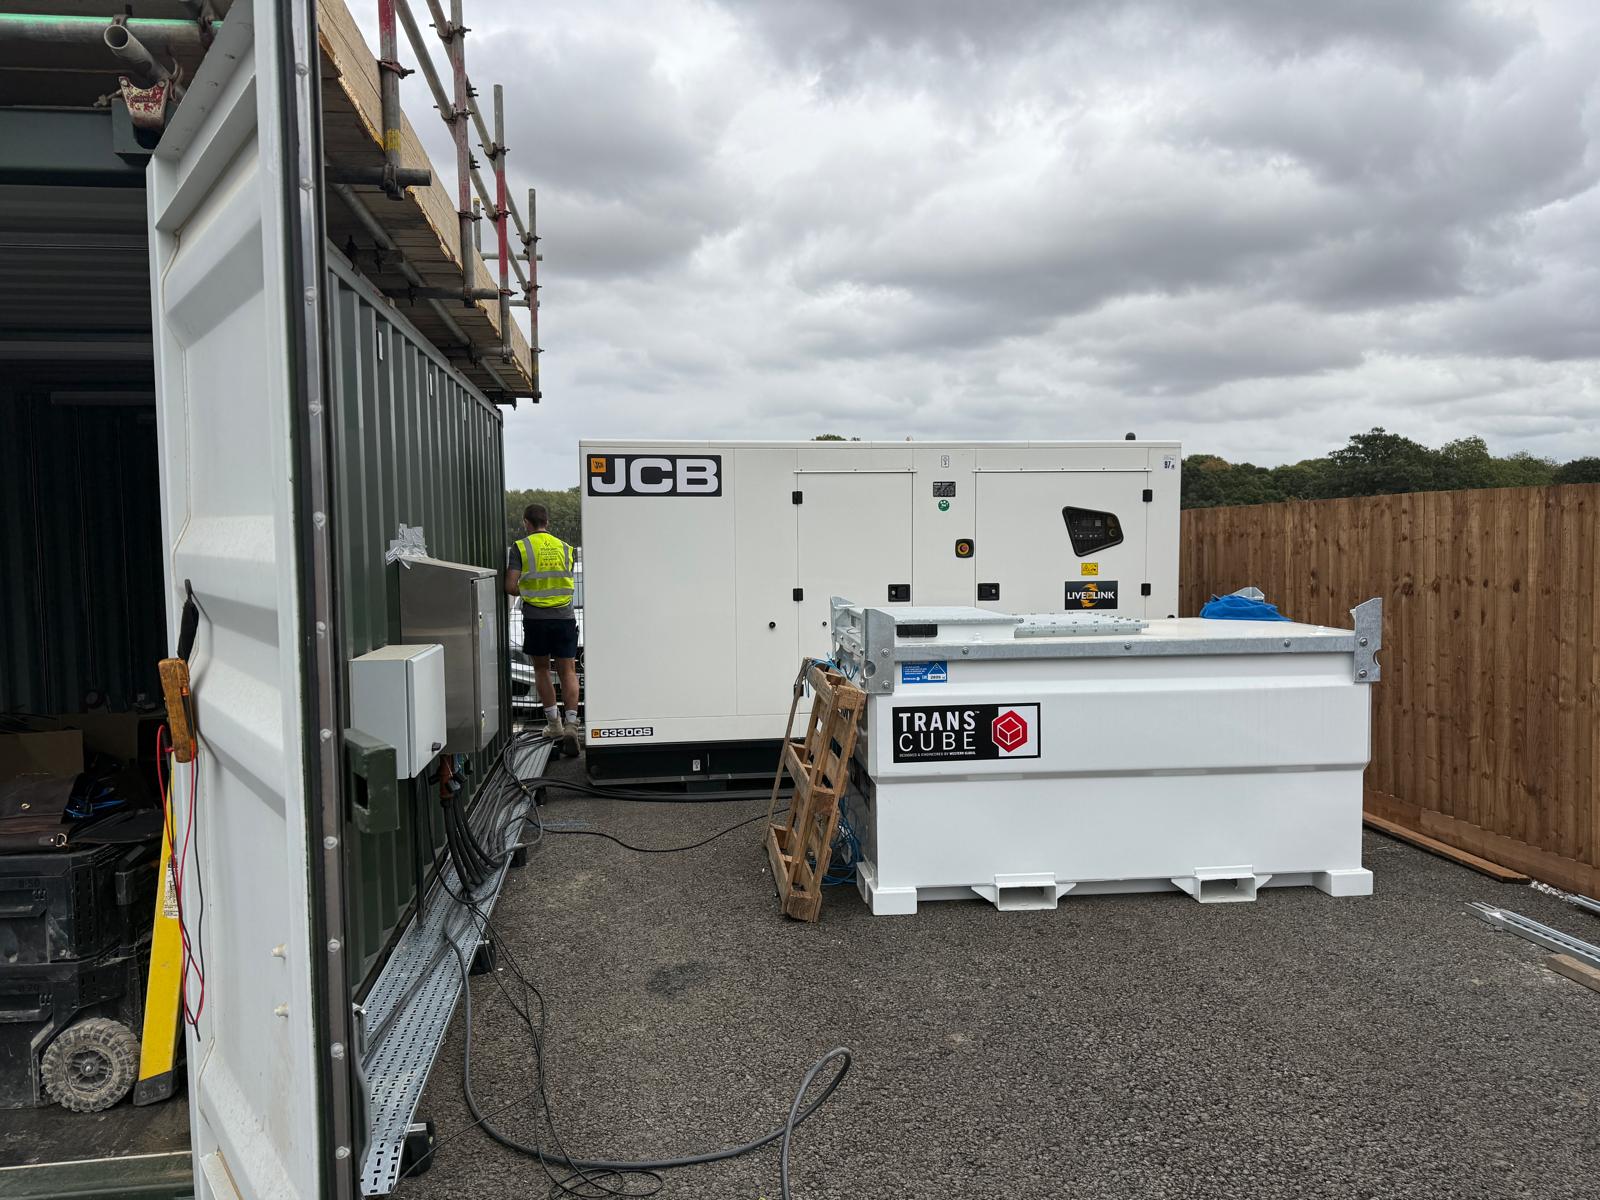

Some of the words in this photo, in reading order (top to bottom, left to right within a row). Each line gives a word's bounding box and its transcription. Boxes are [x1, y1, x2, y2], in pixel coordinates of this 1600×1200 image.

[591, 457, 719, 493] JCB
[1067, 591, 1087, 600] LIVE
[1094, 591, 1115, 599] LINK
[898, 710, 976, 732] TRANS
[899, 731, 976, 752] CUBE
